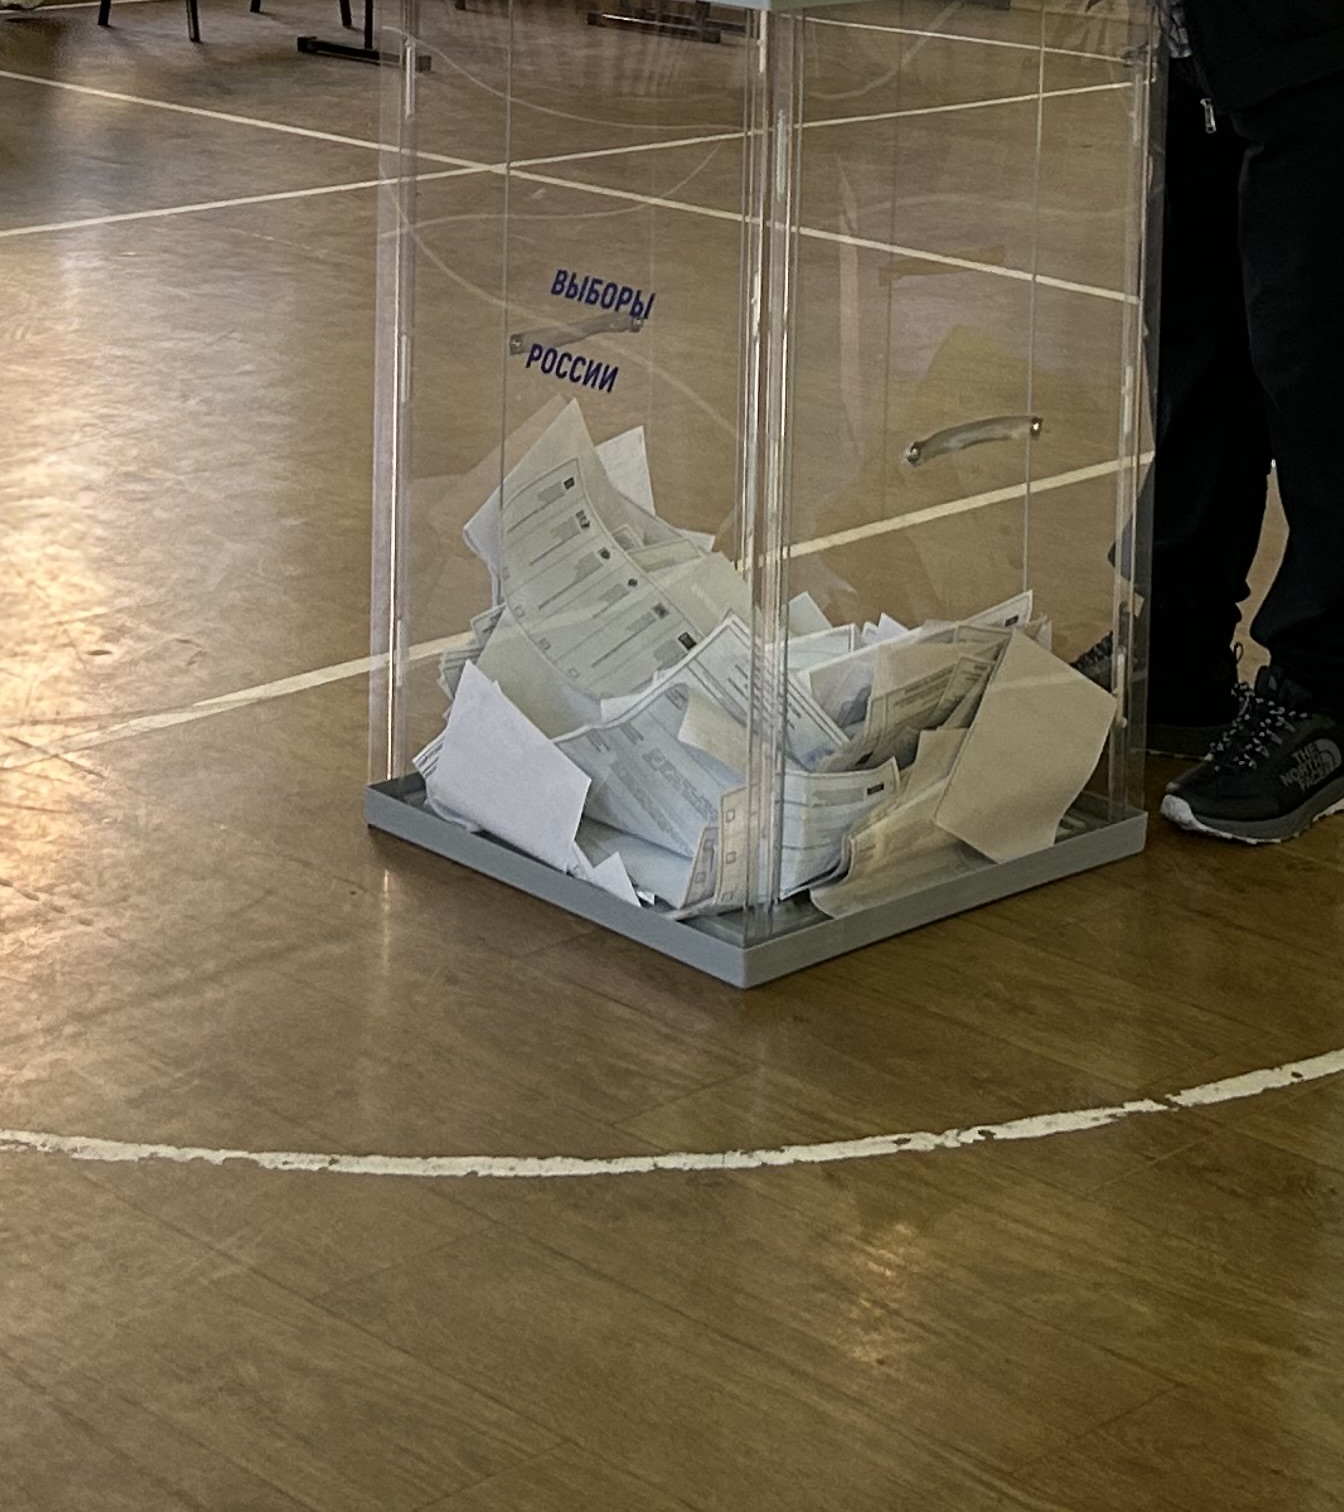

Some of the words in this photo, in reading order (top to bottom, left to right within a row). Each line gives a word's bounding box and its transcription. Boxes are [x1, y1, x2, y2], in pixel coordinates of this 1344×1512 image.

[550, 269, 656, 320] ВЫБОРЫ
[525, 343, 620, 393] РОССИИ
[1279, 752, 1323, 788] NORTH
[1291, 742, 1316, 765] THE
